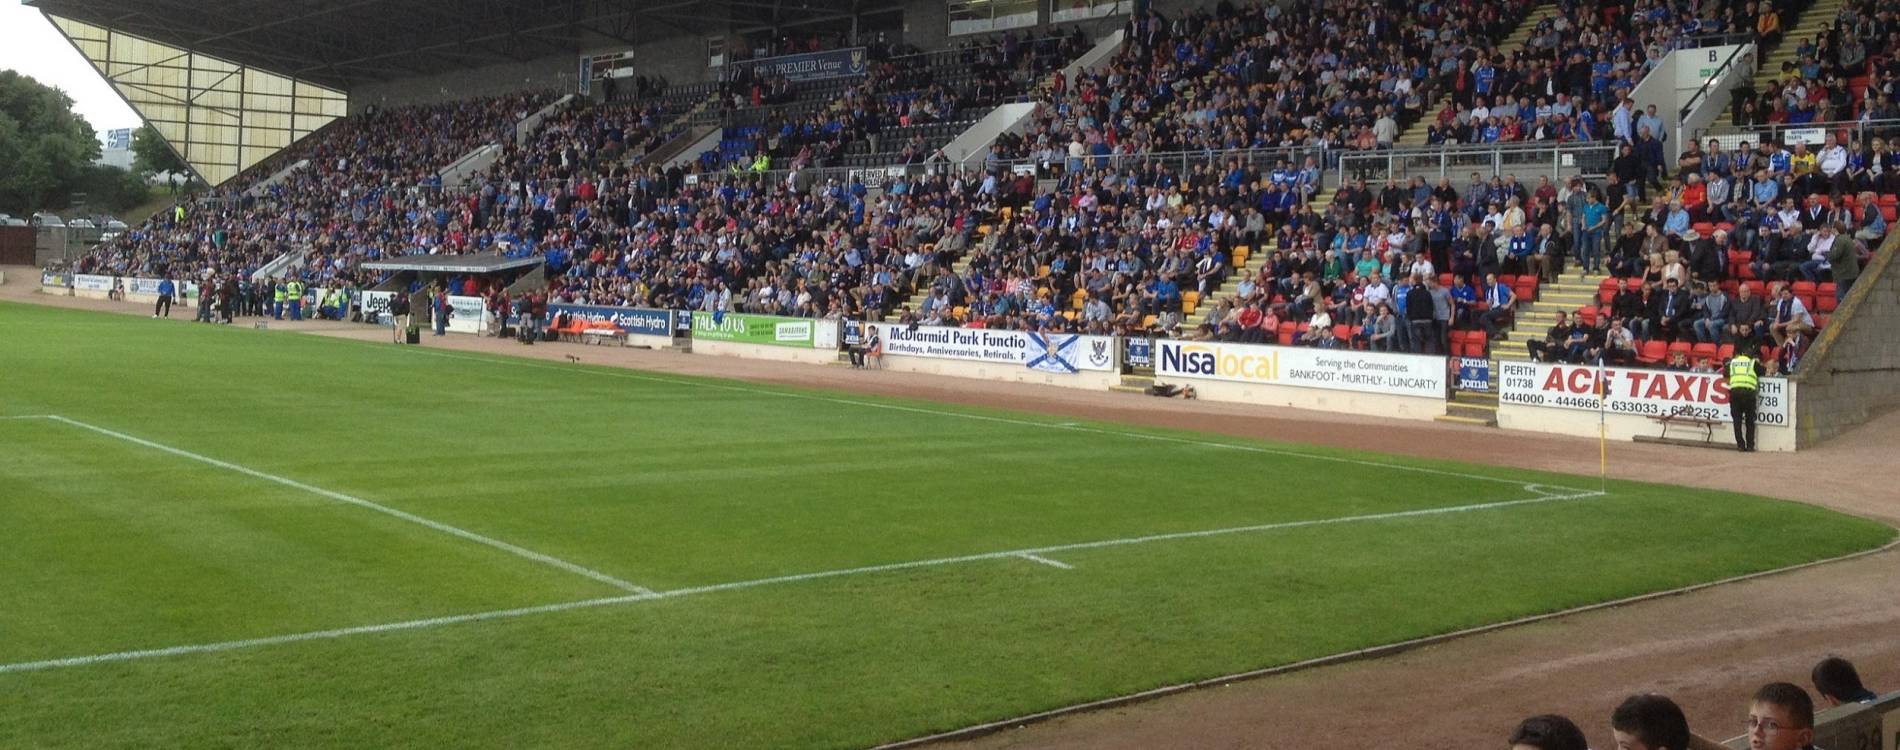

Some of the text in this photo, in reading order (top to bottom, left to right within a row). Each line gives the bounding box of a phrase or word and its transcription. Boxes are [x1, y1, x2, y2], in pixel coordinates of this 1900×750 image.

[1709, 50, 1717, 62] B
[775, 60, 817, 75] PREMIER
[818, 59, 842, 70] Venue
[367, 293, 389, 312] Jeep
[619, 314, 645, 328] Scottish
[646, 315, 665, 330] Hydro
[733, 317, 745, 333] US
[890, 327, 1026, 349] McDiarmid Park Functio
[889, 343, 925, 355] Birthdays,
[927, 345, 981, 359] Anniversaries,
[984, 349, 1016, 360] Retirals.
[1316, 357, 1408, 373] Serving the Communities
[1290, 369, 1335, 382] BANKFOOT
[1342, 373, 1383, 386] MURTHLY
[1389, 377, 1438, 390] LUNCARTY
[1504, 365, 1781, 405] PERTH ACE TAXIS RTH
[1506, 378, 1778, 407] 01738 738
[1502, 392, 1544, 404] 444000
[1555, 396, 1600, 409] 444666
[1612, 401, 1658, 414] 633033
[1671, 405, 1719, 419] 622252
[1757, 412, 1784, 424] 000
